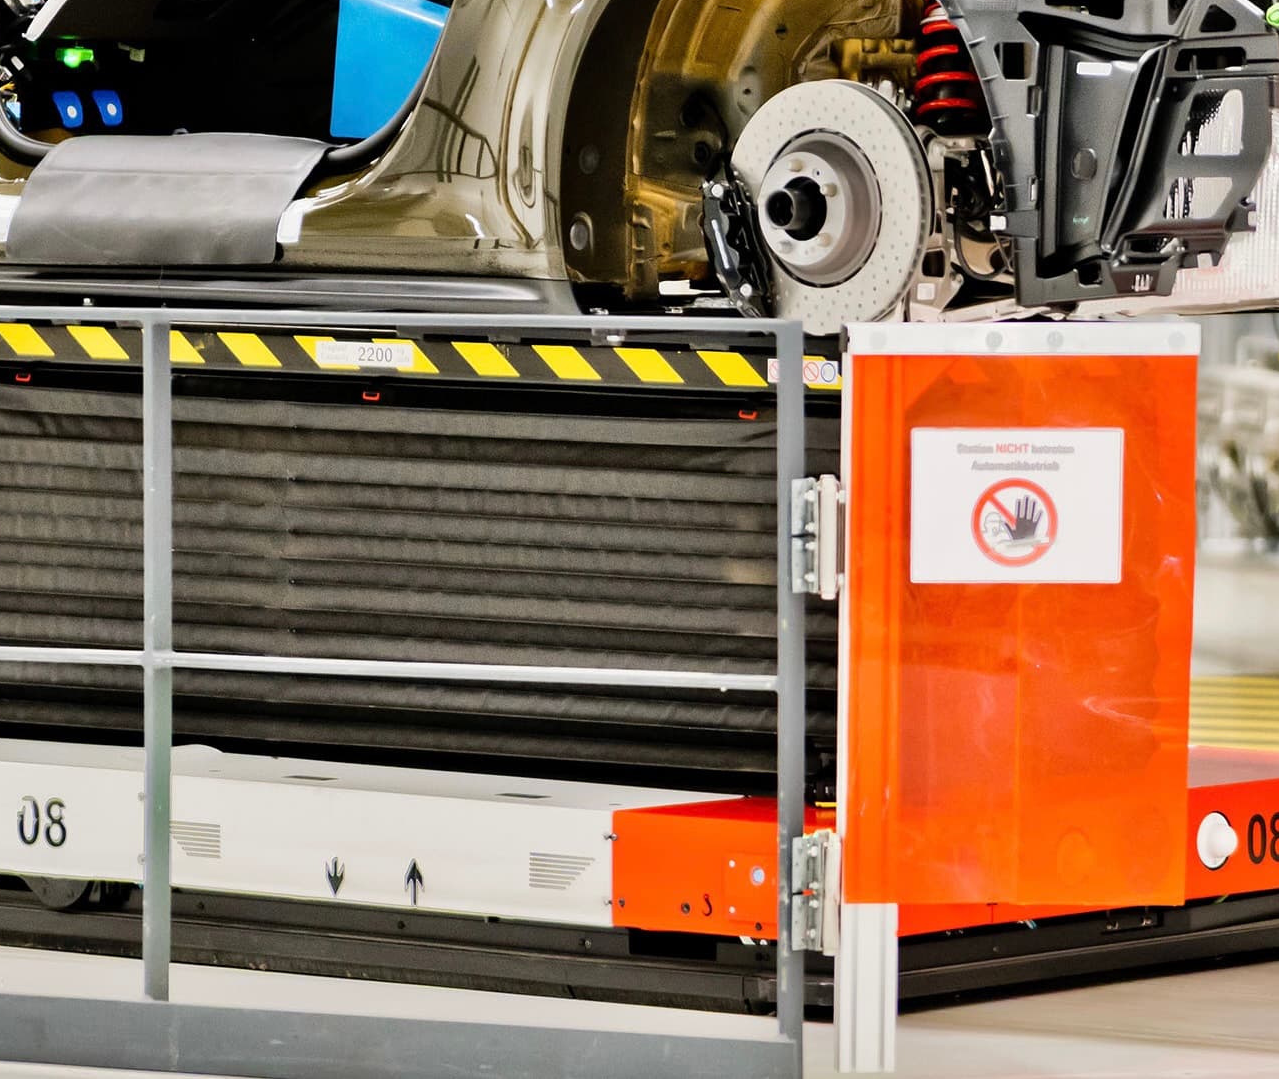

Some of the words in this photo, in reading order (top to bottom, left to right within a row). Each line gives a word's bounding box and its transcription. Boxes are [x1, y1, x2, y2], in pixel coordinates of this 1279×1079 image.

[357, 346, 393, 363] 2200
[995, 443, 1029, 454] NICHT
[17, 795, 67, 847] 08
